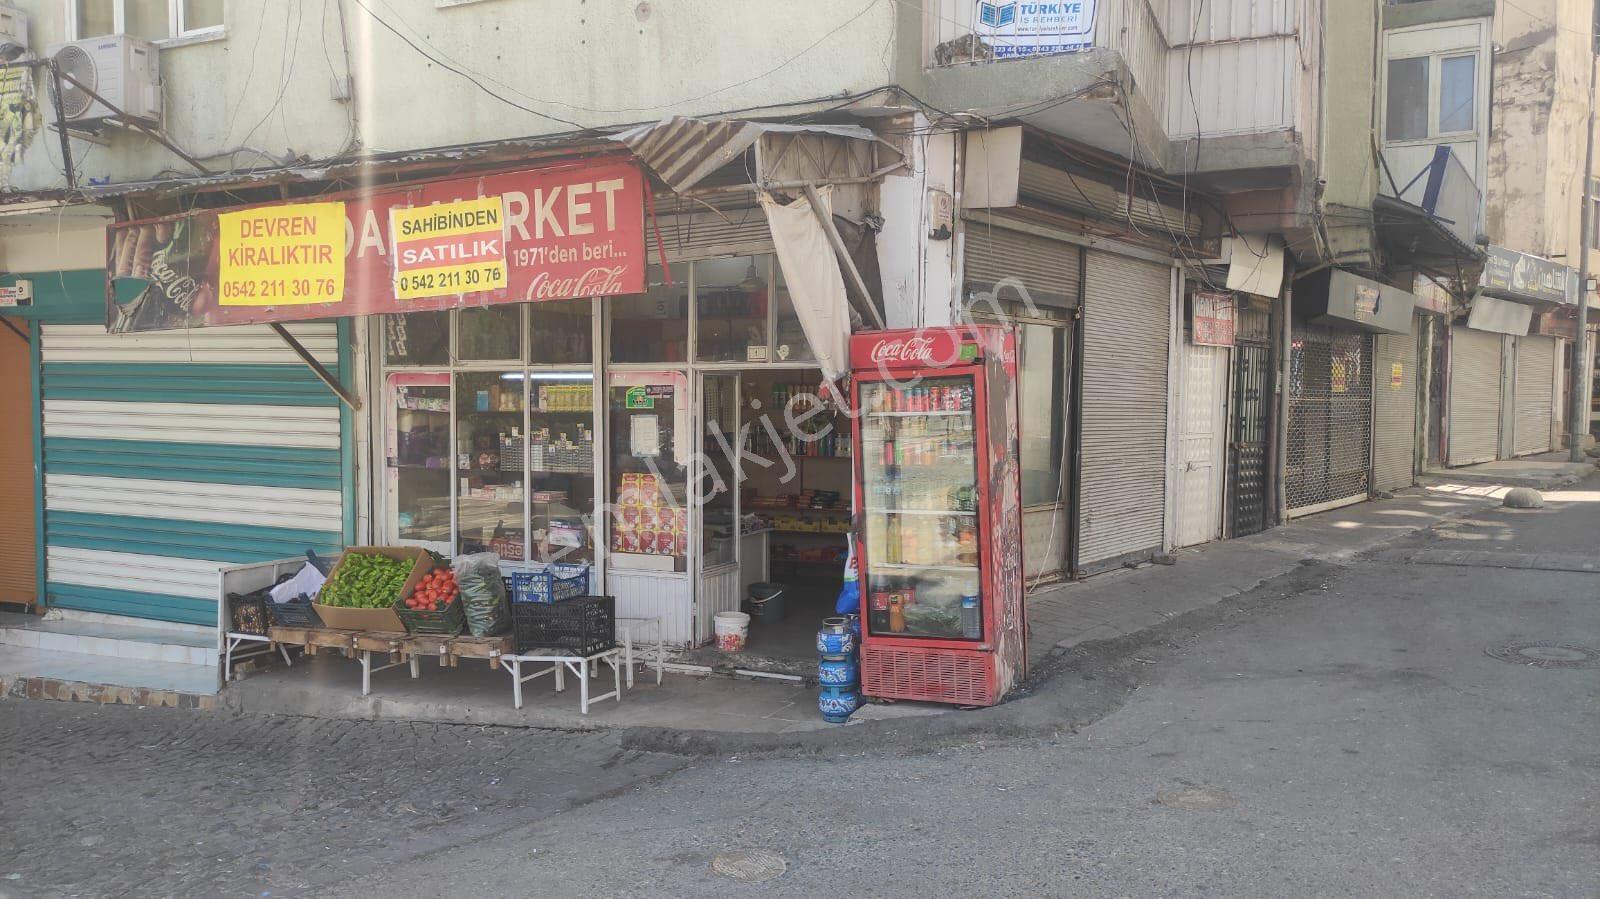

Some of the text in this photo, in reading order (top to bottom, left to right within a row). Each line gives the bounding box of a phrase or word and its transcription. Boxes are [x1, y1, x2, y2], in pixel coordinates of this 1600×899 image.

[402, 208, 498, 236] SAHİBİNDEN
[480, 178, 625, 243] RKET
[240, 215, 317, 239] DEVREN
[228, 243, 333, 267] KİRALIKTIR
[402, 239, 500, 265] SATILIK
[513, 239, 628, 267] 1971'den beri...
[223, 278, 335, 298] 0542 211 30 76
[400, 267, 501, 292] 0 542 211 30 76
[870, 336, 936, 363] Coca-Cola
